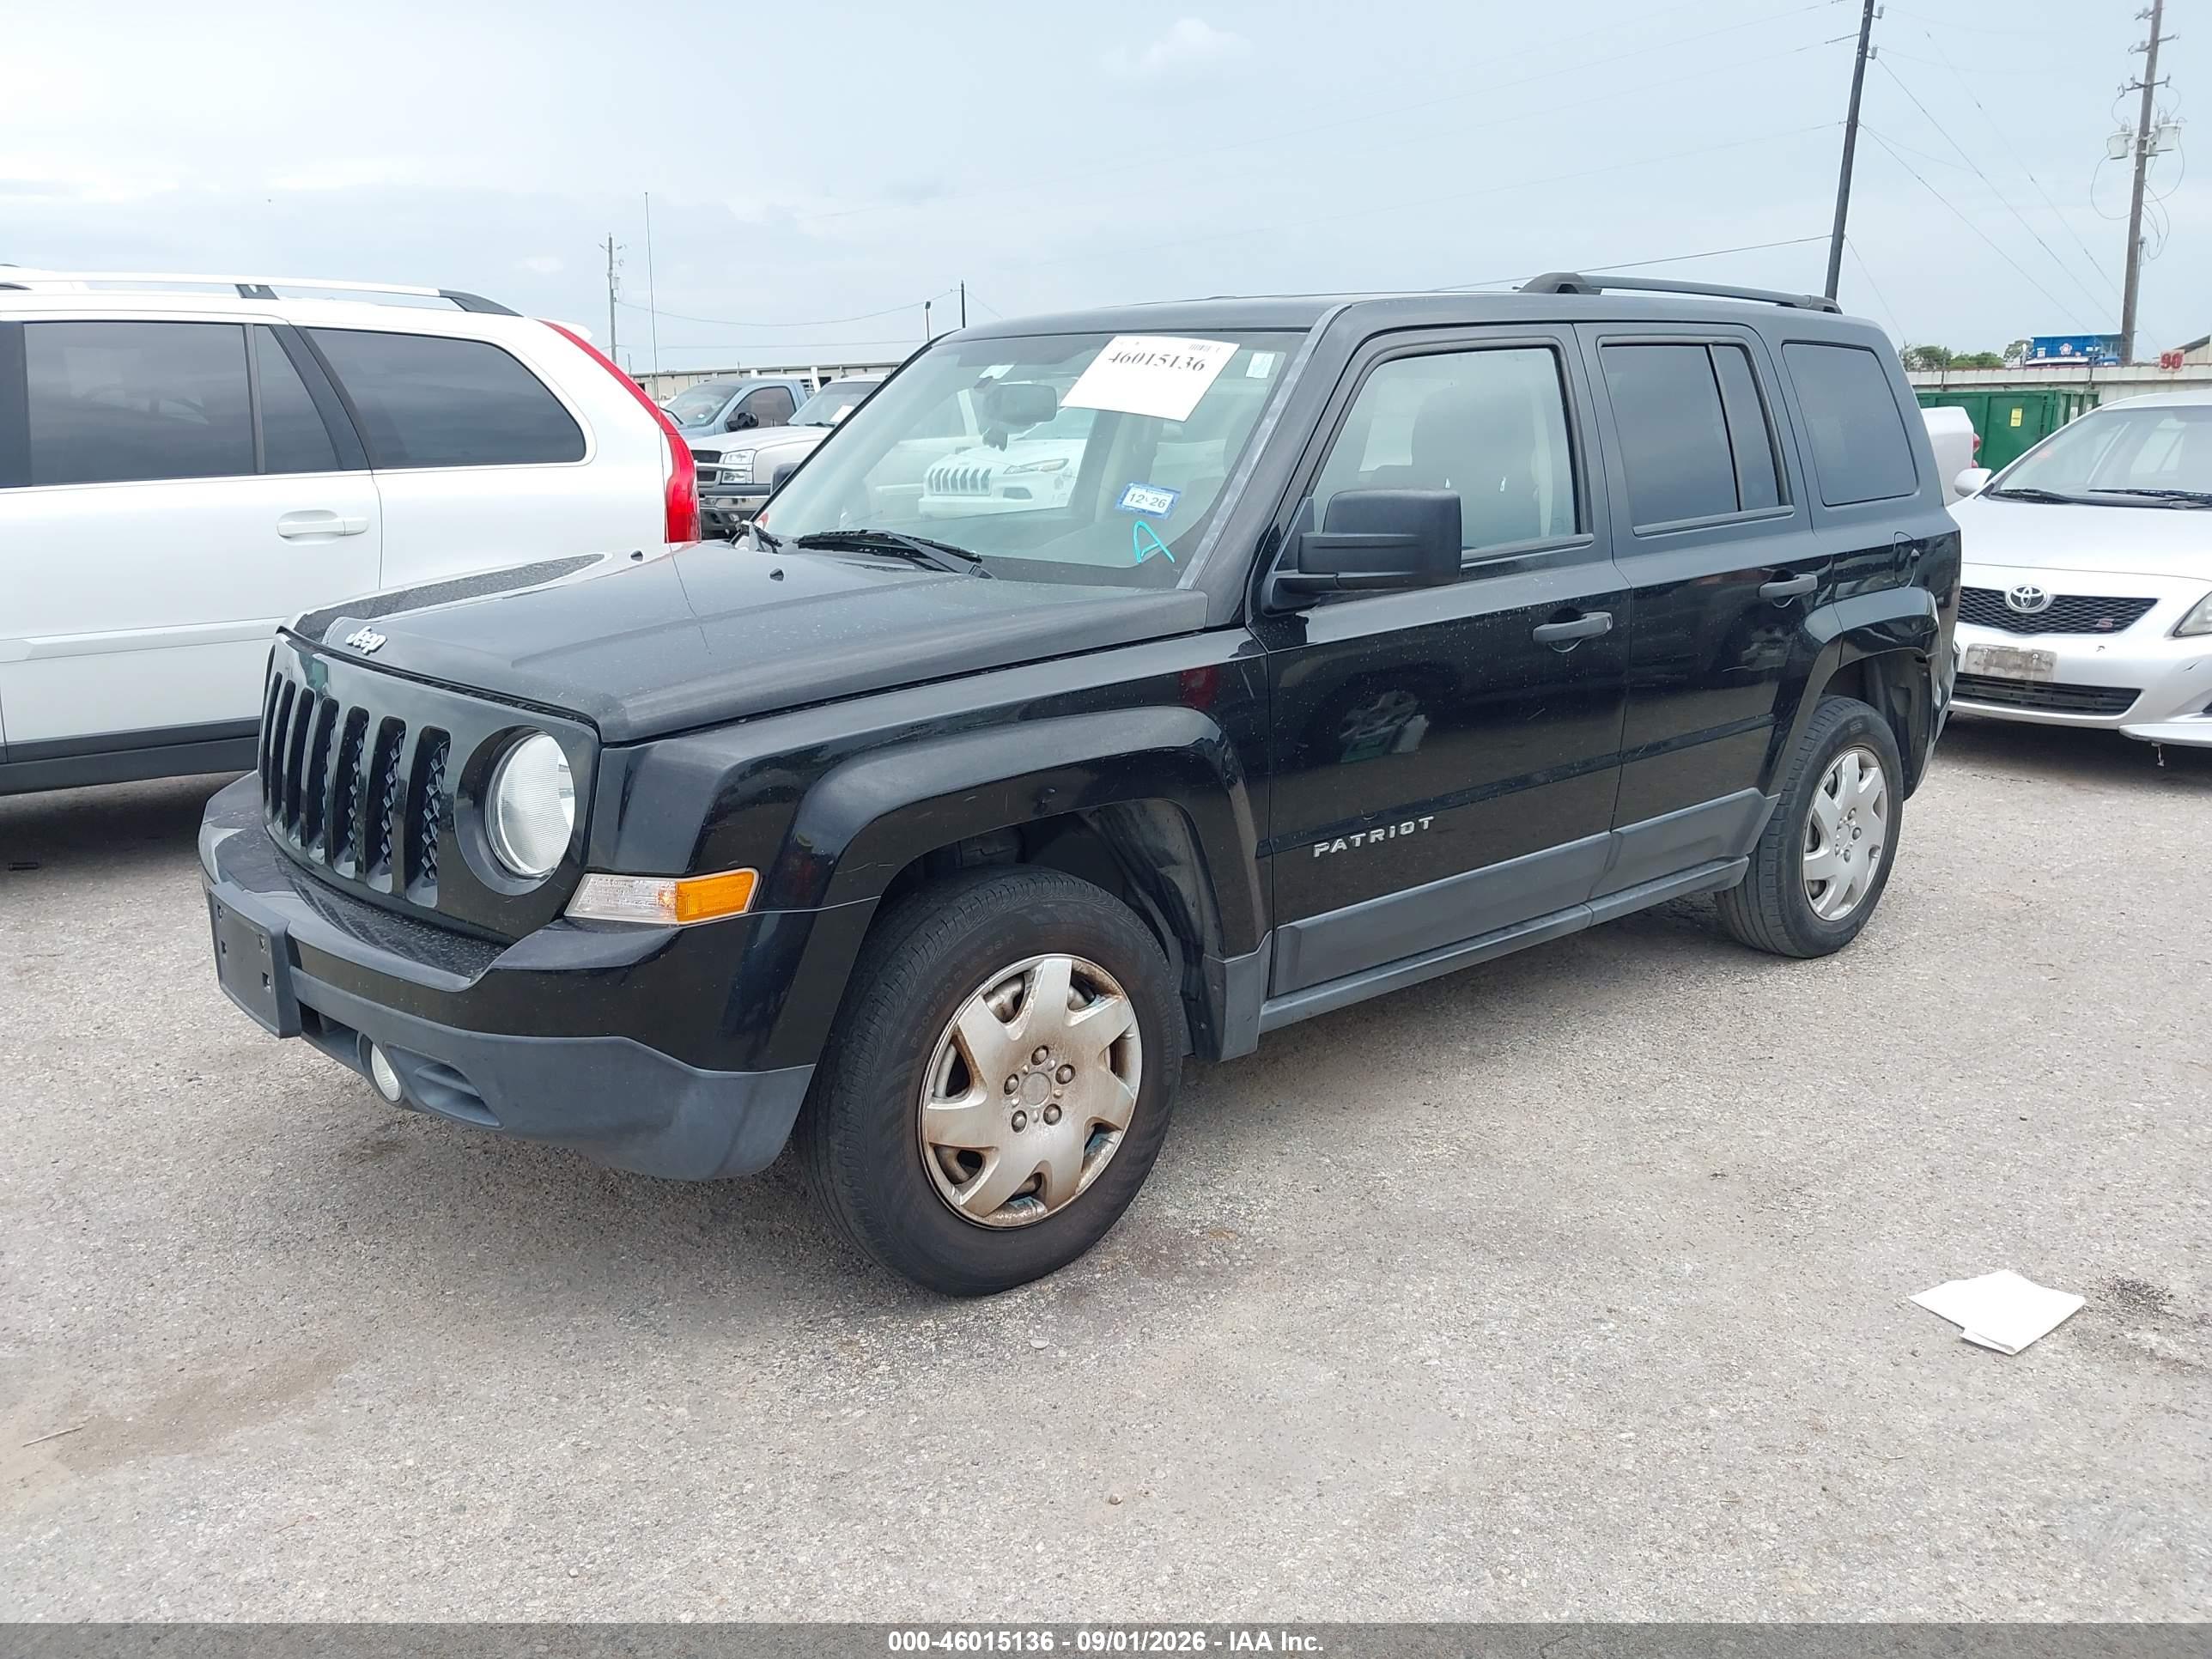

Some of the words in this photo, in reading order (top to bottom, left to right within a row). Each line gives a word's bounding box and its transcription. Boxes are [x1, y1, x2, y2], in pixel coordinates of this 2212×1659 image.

[1108, 350, 1206, 372] 46015136
[1149, 496, 1168, 508] 26
[1133, 520, 1176, 563] A
[345, 625, 387, 655] Jeep
[1313, 815, 1435, 858] PATRIOT
